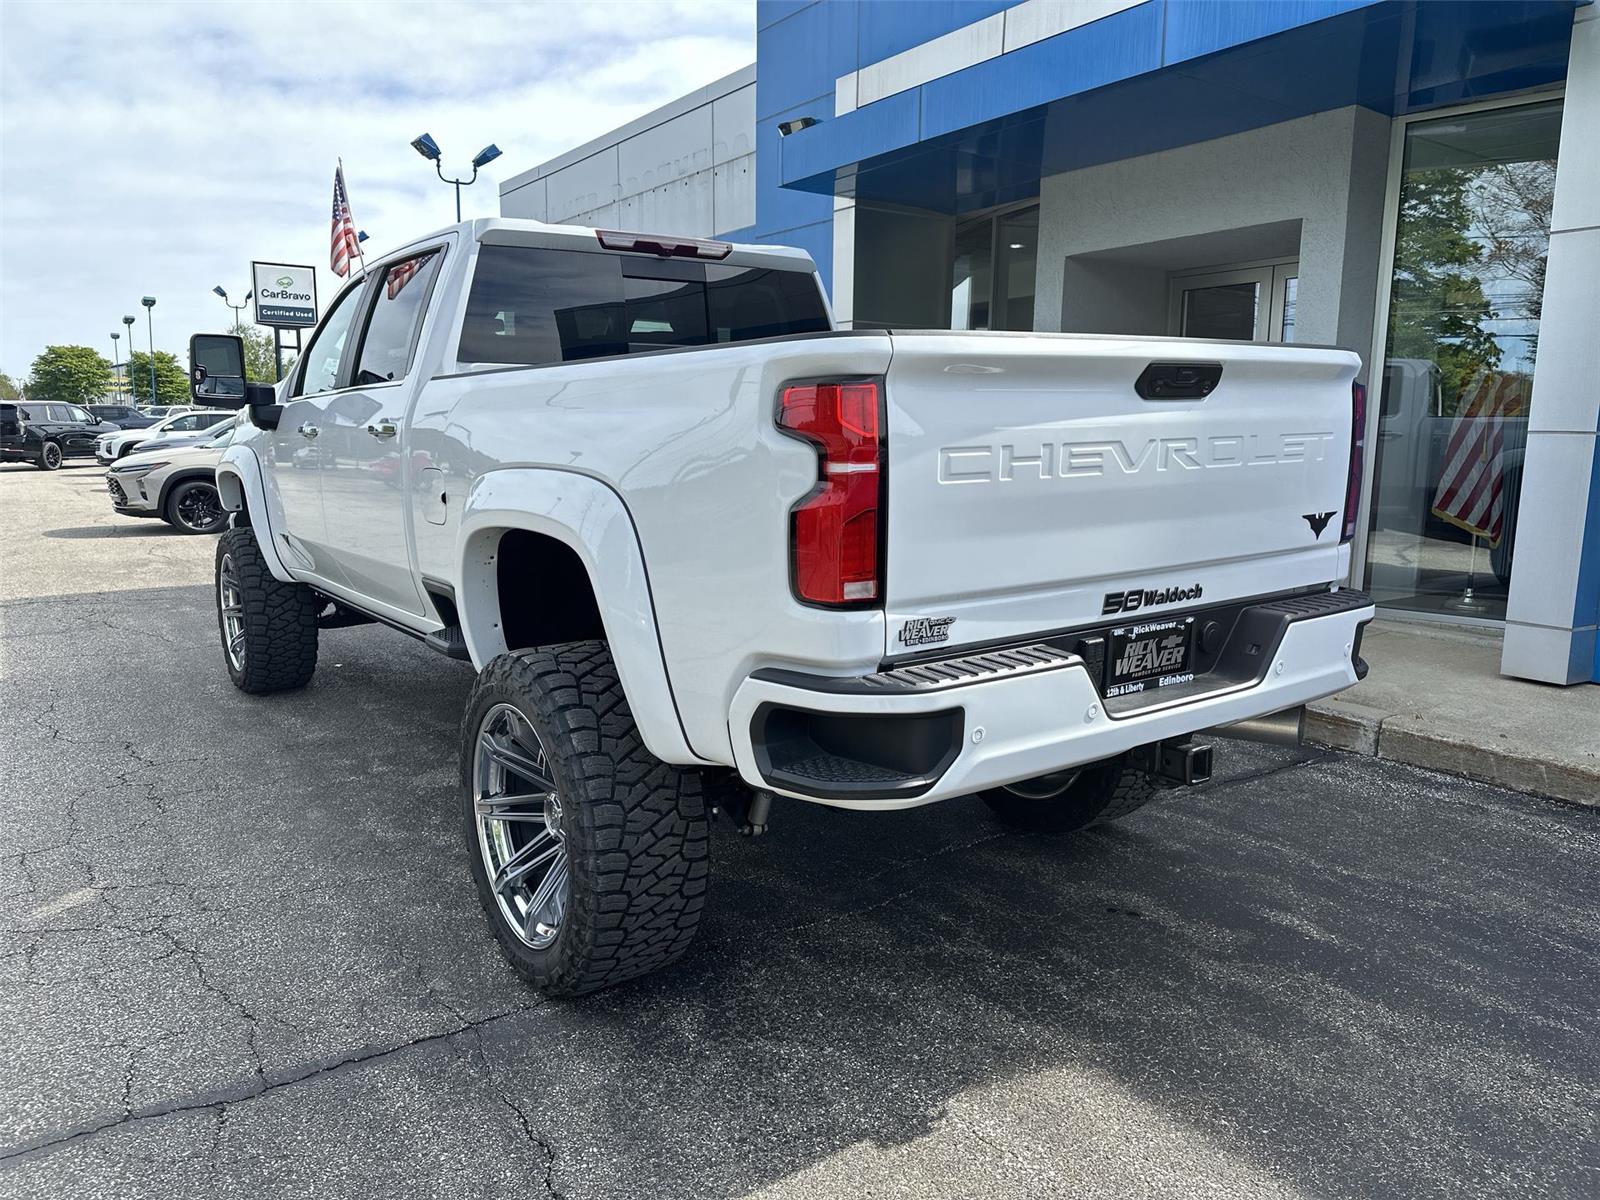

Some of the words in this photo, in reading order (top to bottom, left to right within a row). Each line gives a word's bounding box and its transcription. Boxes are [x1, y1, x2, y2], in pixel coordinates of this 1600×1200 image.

[261, 288, 311, 301] CarBravo
[262, 309, 294, 317] Certified
[937, 431, 1335, 485] CHEVROLET
[1143, 583, 1203, 607] Waldoch
[899, 624, 949, 641] WEAVER
[904, 618, 931, 631] RICK
[1124, 638, 1158, 658] RICK
[1115, 646, 1185, 676] WEAVER
[1158, 673, 1194, 687] Edinboro
[1106, 686, 1119, 697] 12th
[1125, 682, 1145, 693] Liberty
